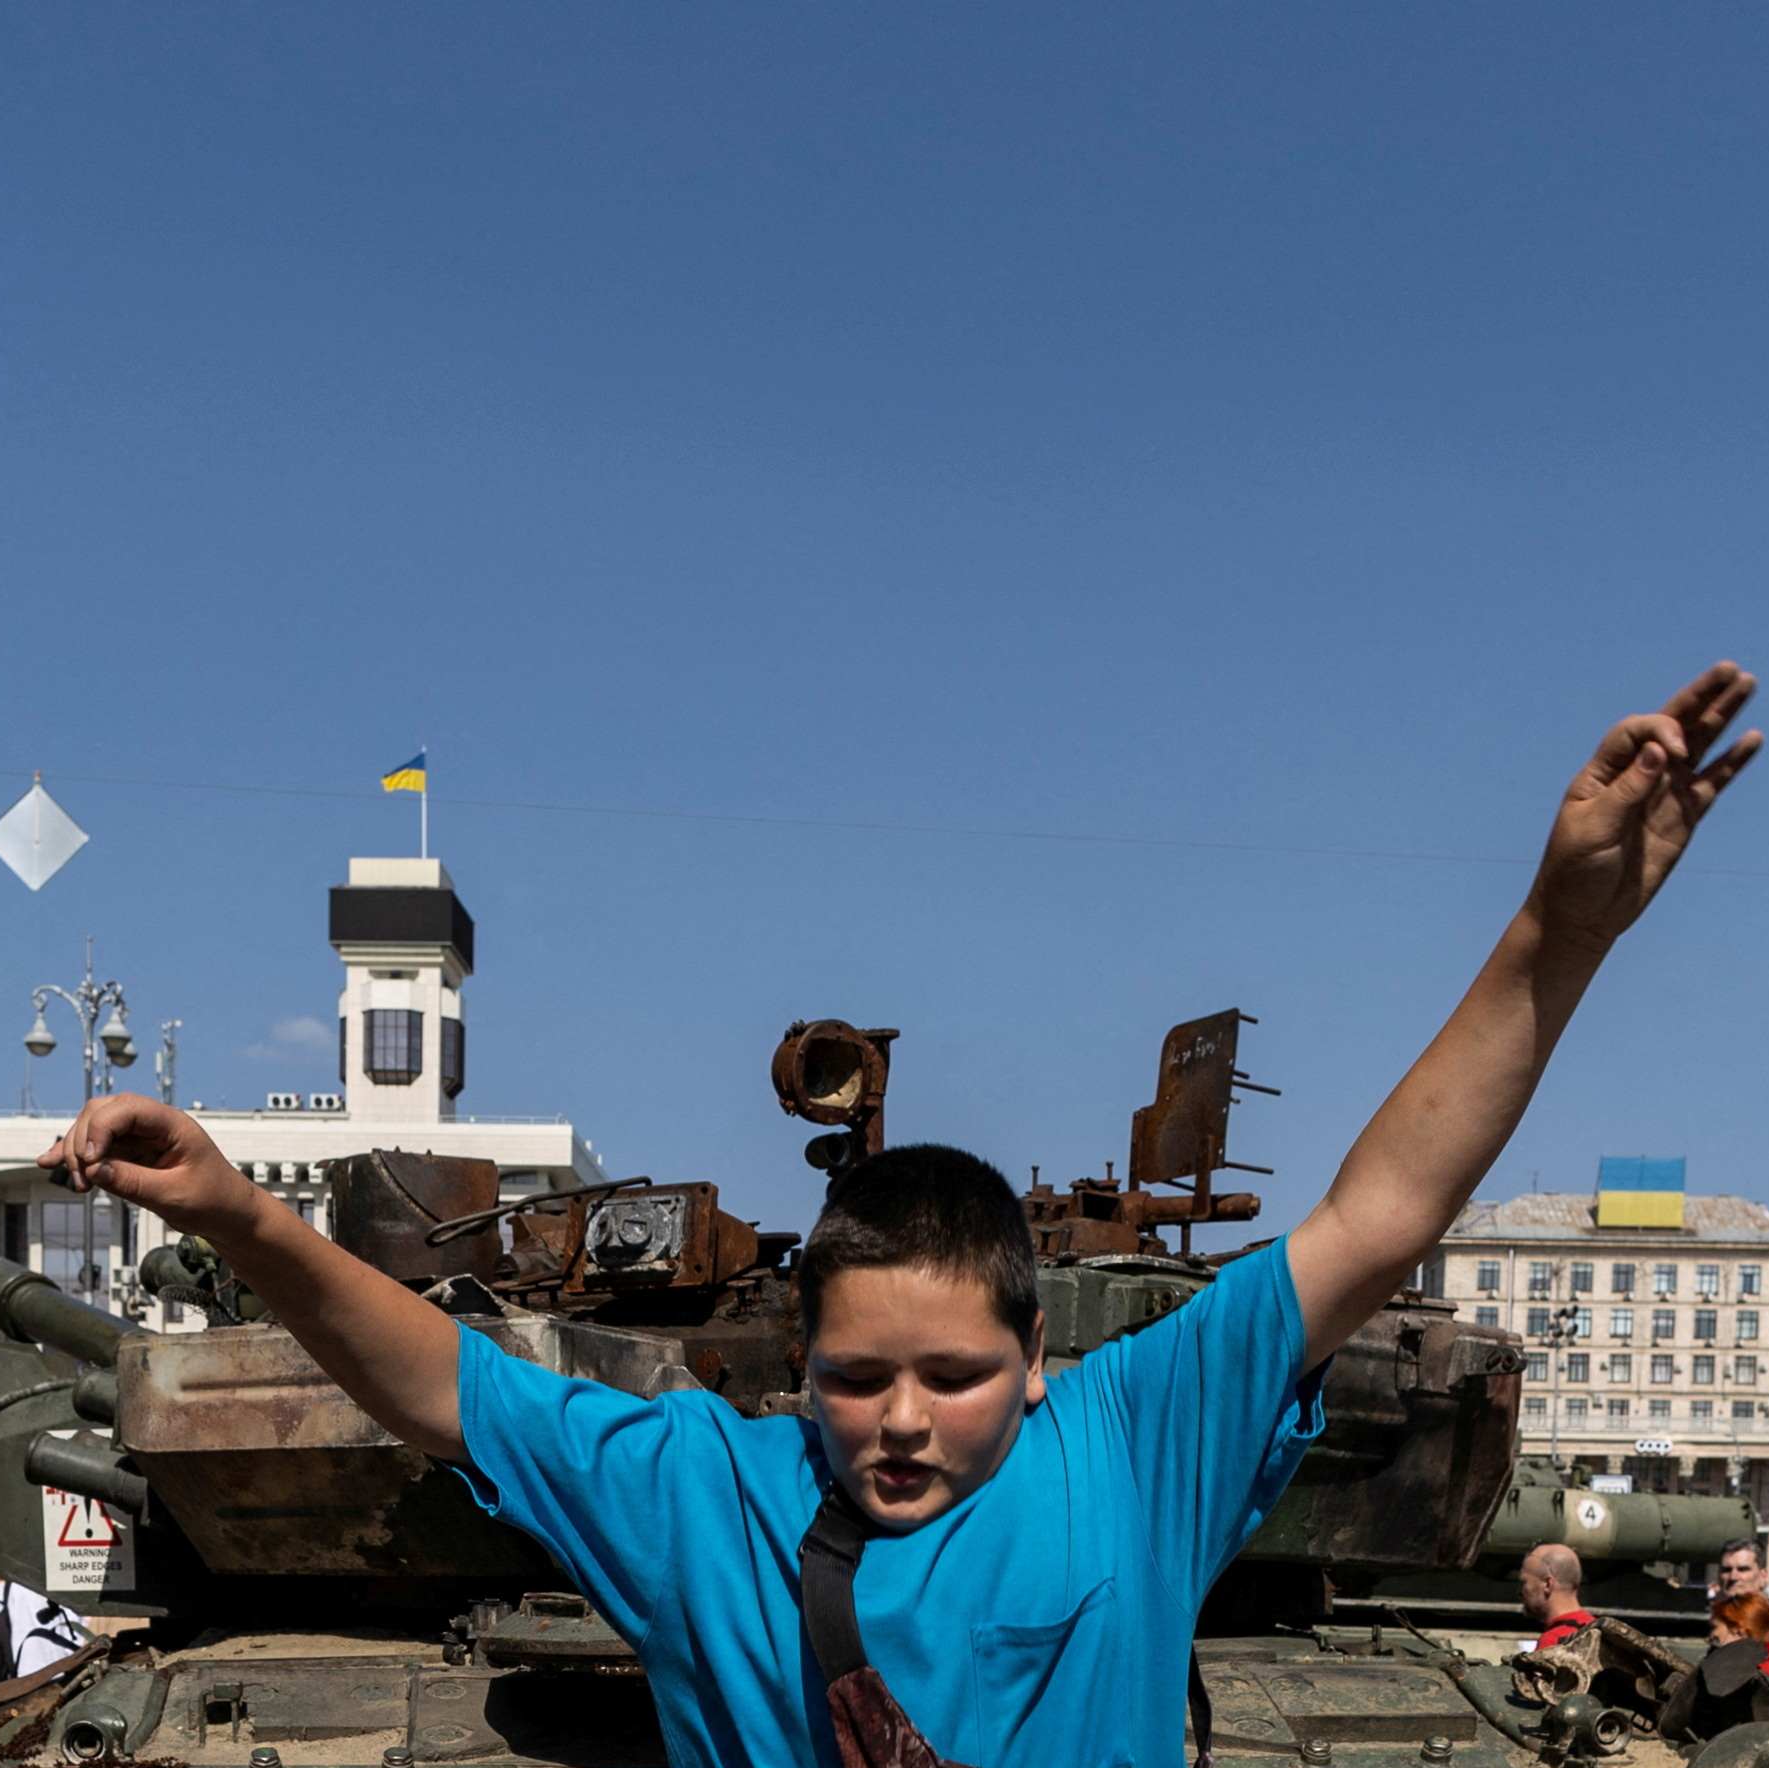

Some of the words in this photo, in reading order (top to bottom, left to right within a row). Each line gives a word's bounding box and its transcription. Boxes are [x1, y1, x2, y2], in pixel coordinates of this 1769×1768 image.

[1584, 1505, 1596, 1520] 4
[69, 1548, 112, 1558] WARNING
[59, 1561, 89, 1571] SHARP
[92, 1561, 123, 1571] EDGES
[72, 1574, 110, 1584] DANGER
